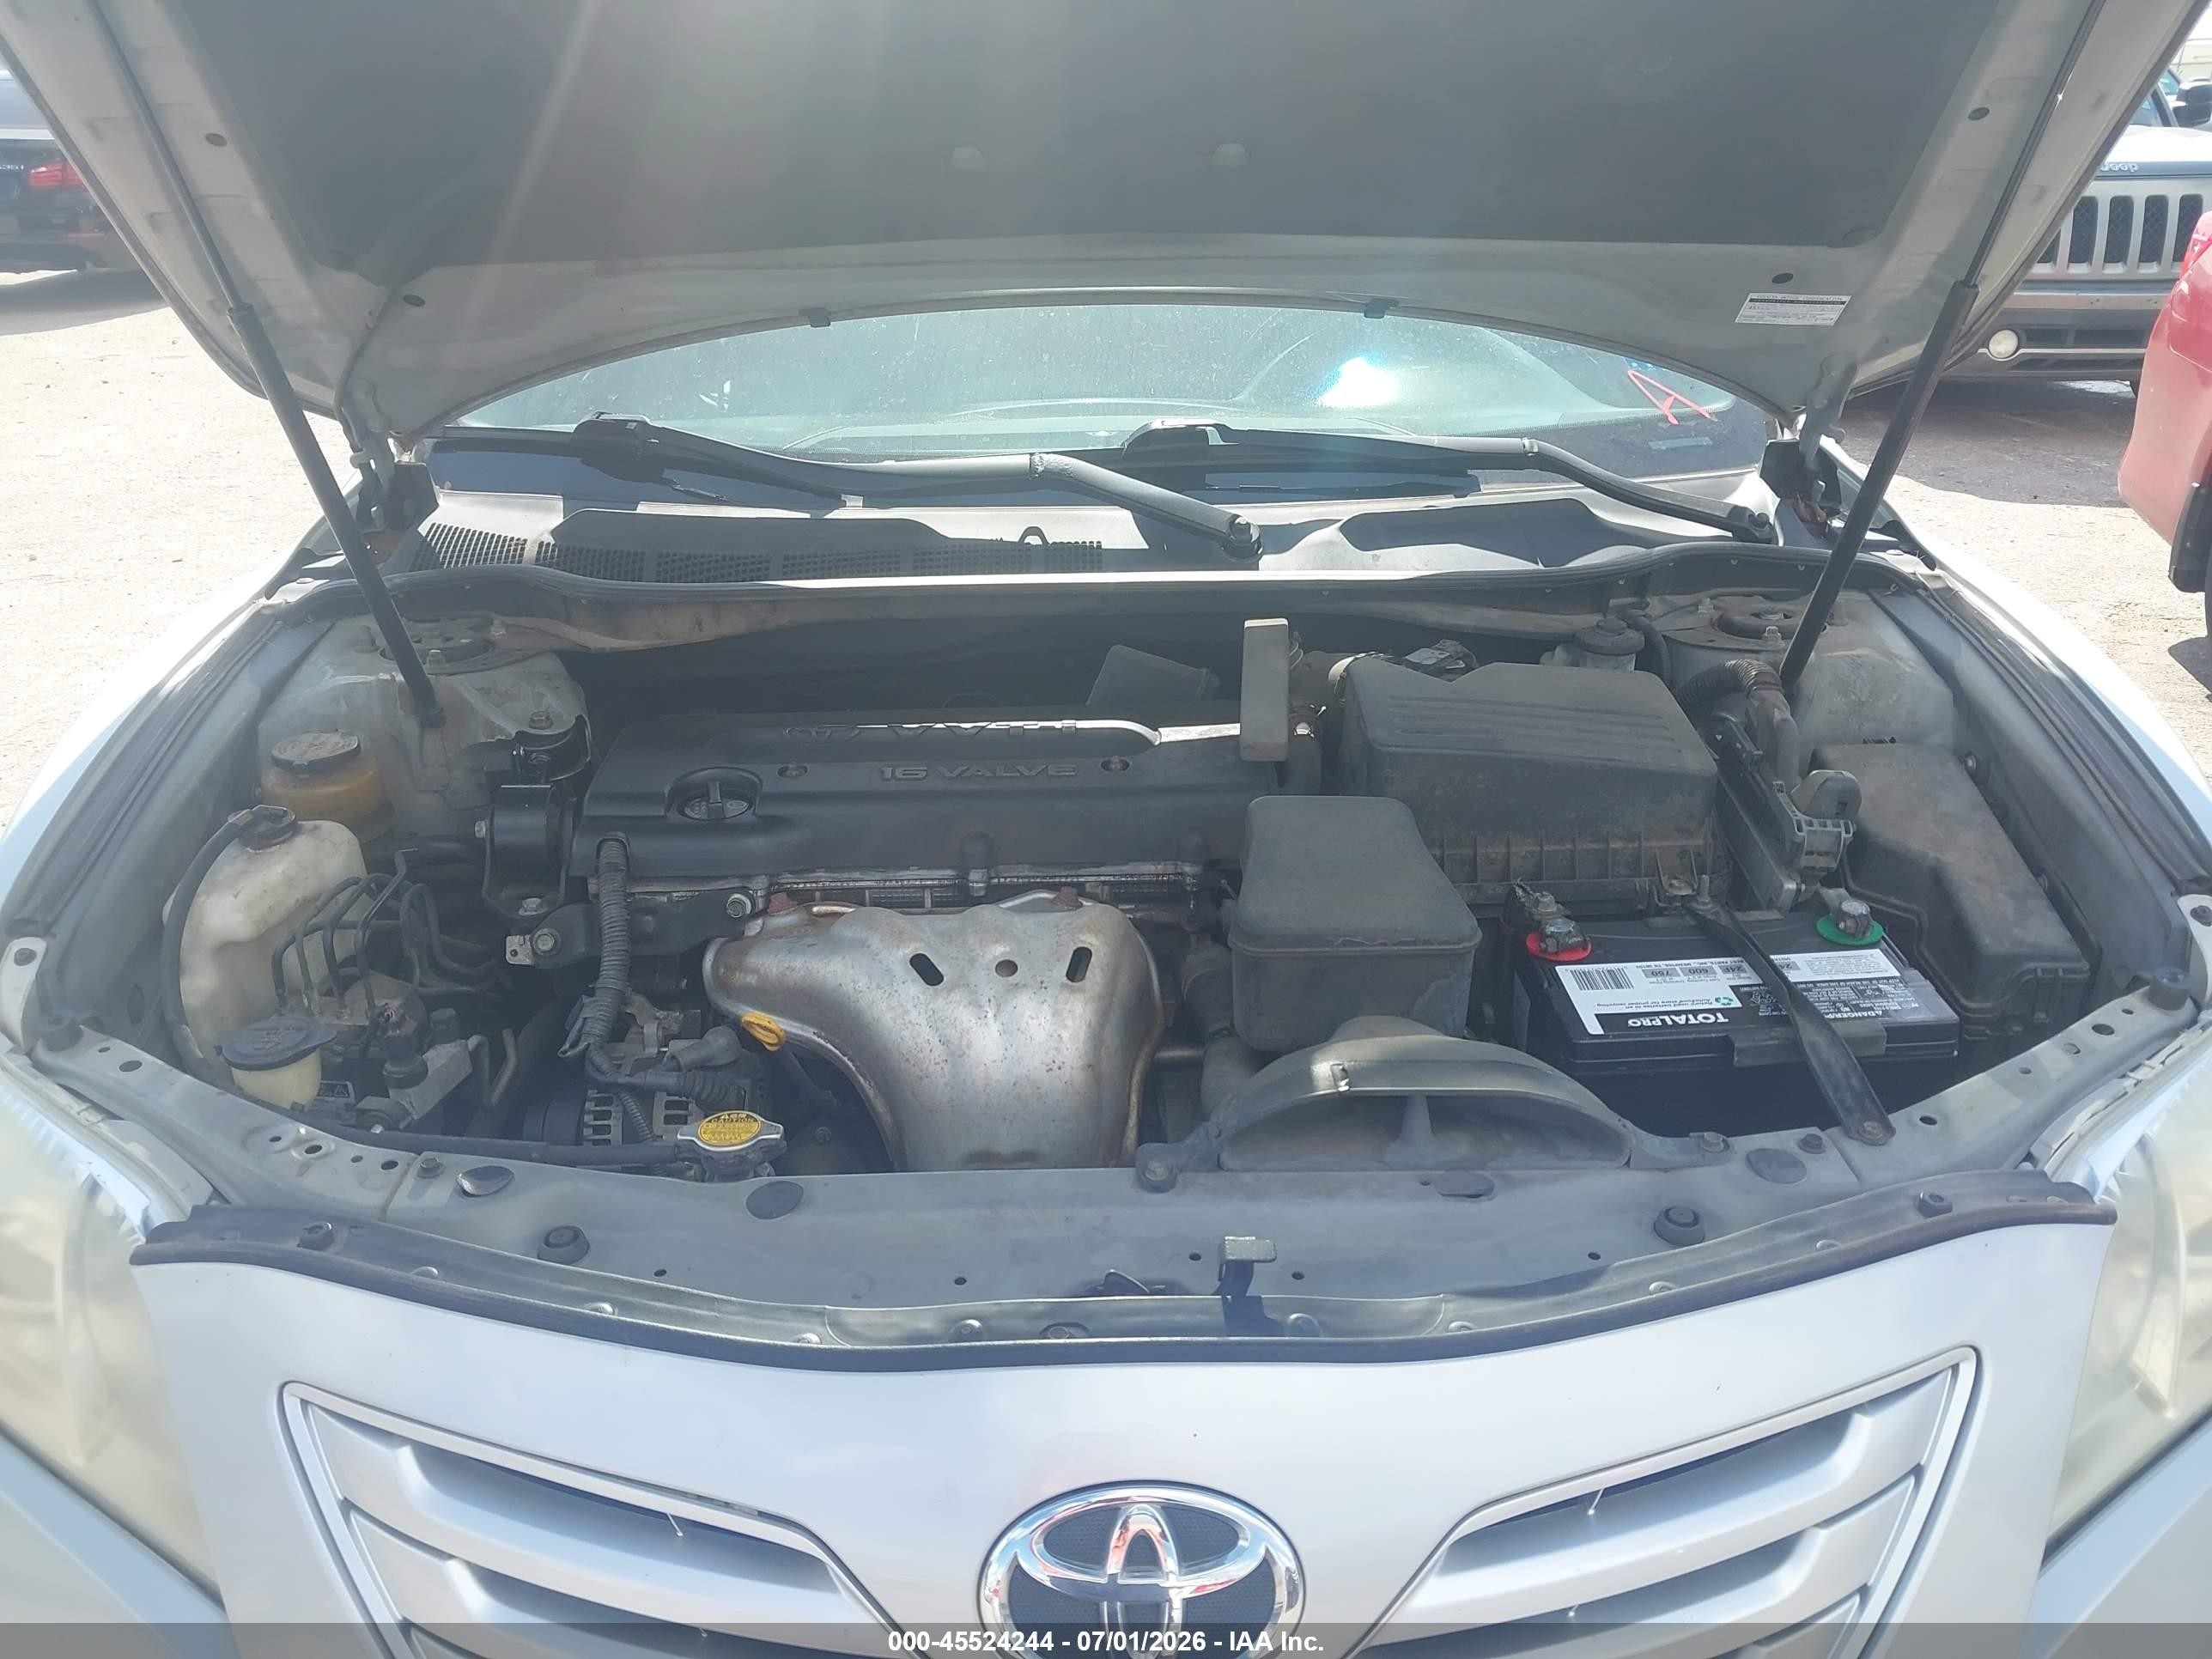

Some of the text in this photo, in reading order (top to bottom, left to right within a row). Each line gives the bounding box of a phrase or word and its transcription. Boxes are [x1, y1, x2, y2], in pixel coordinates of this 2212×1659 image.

[2100, 162, 2138, 173] Jeep
[879, 764, 1078, 781] 16 VALVE
[1628, 1012, 1729, 1027] TOTALPRO
